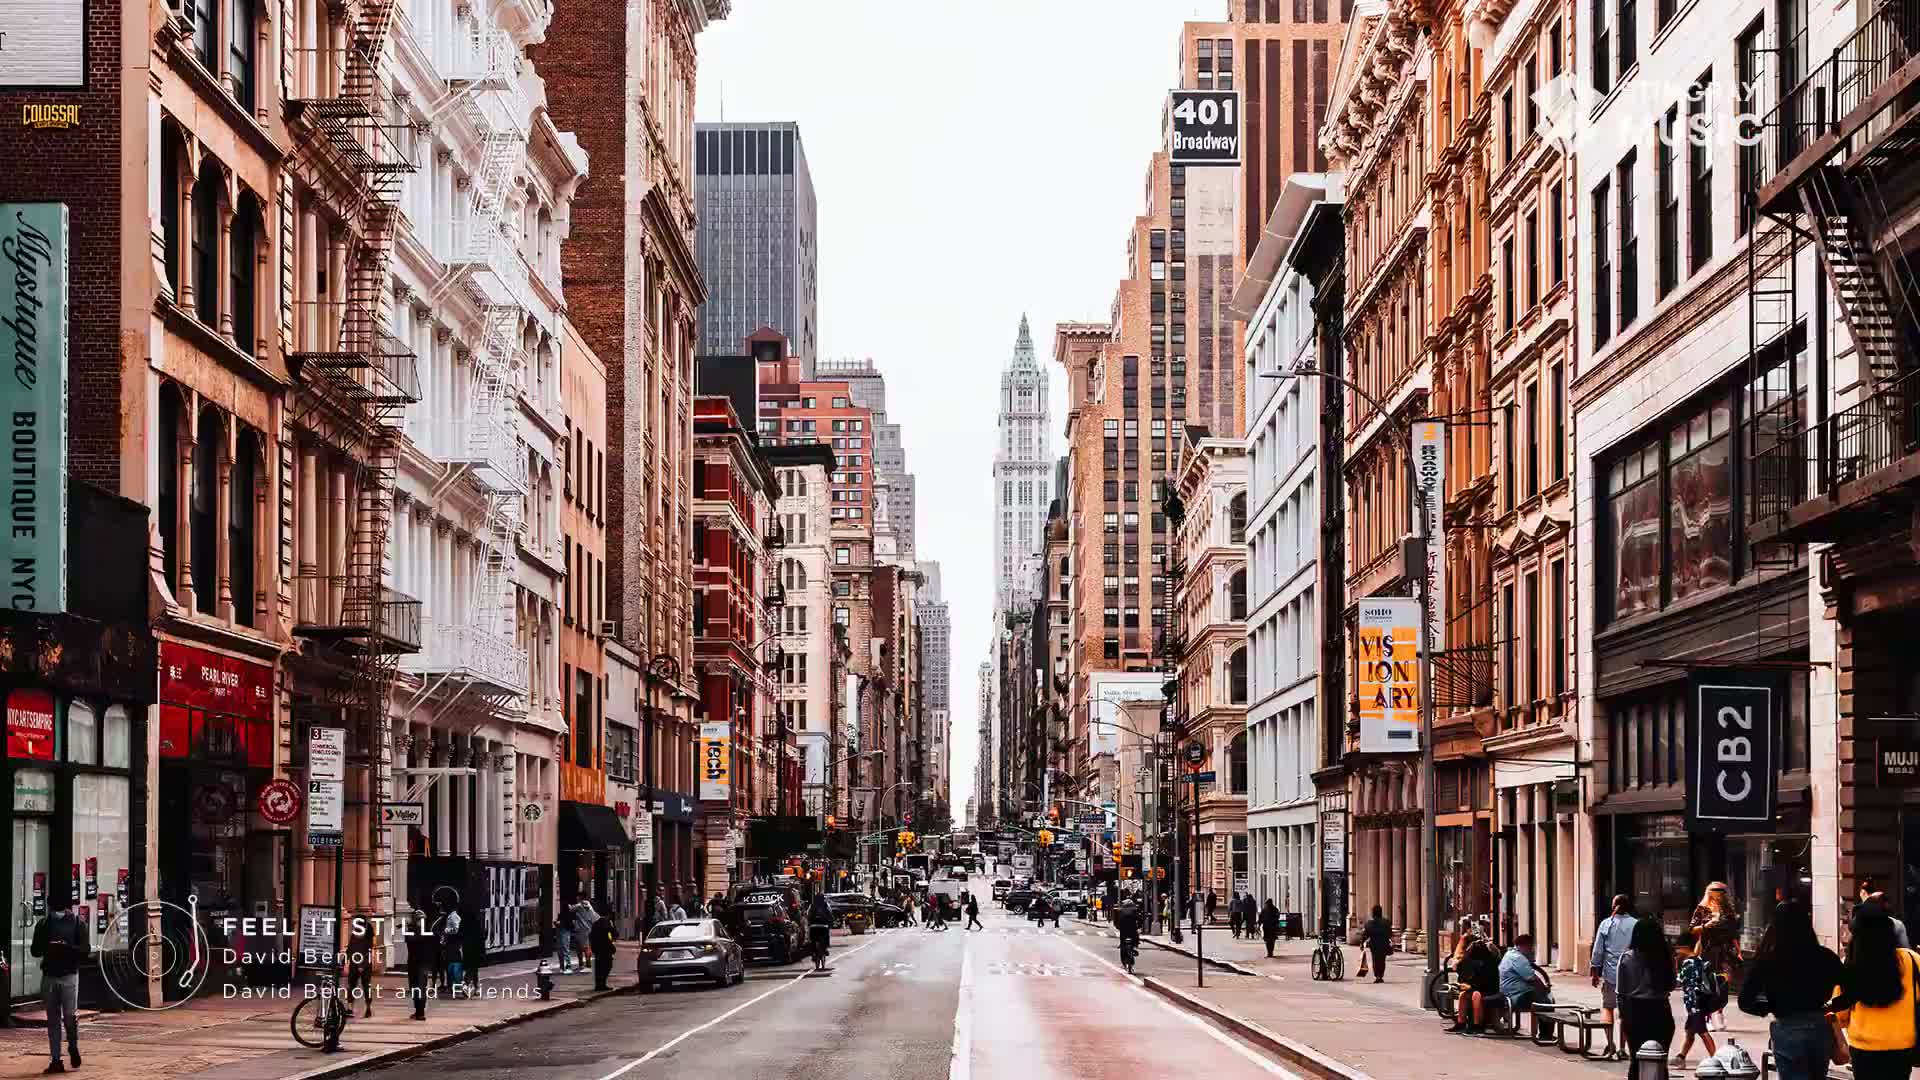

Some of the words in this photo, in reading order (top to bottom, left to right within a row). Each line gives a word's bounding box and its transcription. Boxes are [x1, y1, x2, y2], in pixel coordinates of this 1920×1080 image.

[23, 104, 81, 126] COLOSSAL
[1174, 98, 1233, 125] 401
[1174, 131, 1237, 156] Broadway
[1, 211, 52, 391] Mystique
[12, 411, 37, 539] BOUTIQUE
[11, 558, 37, 610] NYC
[1361, 635, 1395, 658] VIS
[201, 666, 221, 685] PEARL
[221, 671, 240, 688] RIVER
[1367, 661, 1410, 683] ION
[1371, 688, 1417, 709] ARY
[313, 729, 320, 739] 3
[1716, 705, 1753, 802] CB2
[1884, 751, 1919, 766] MUJI
[312, 782, 318, 792] 2
